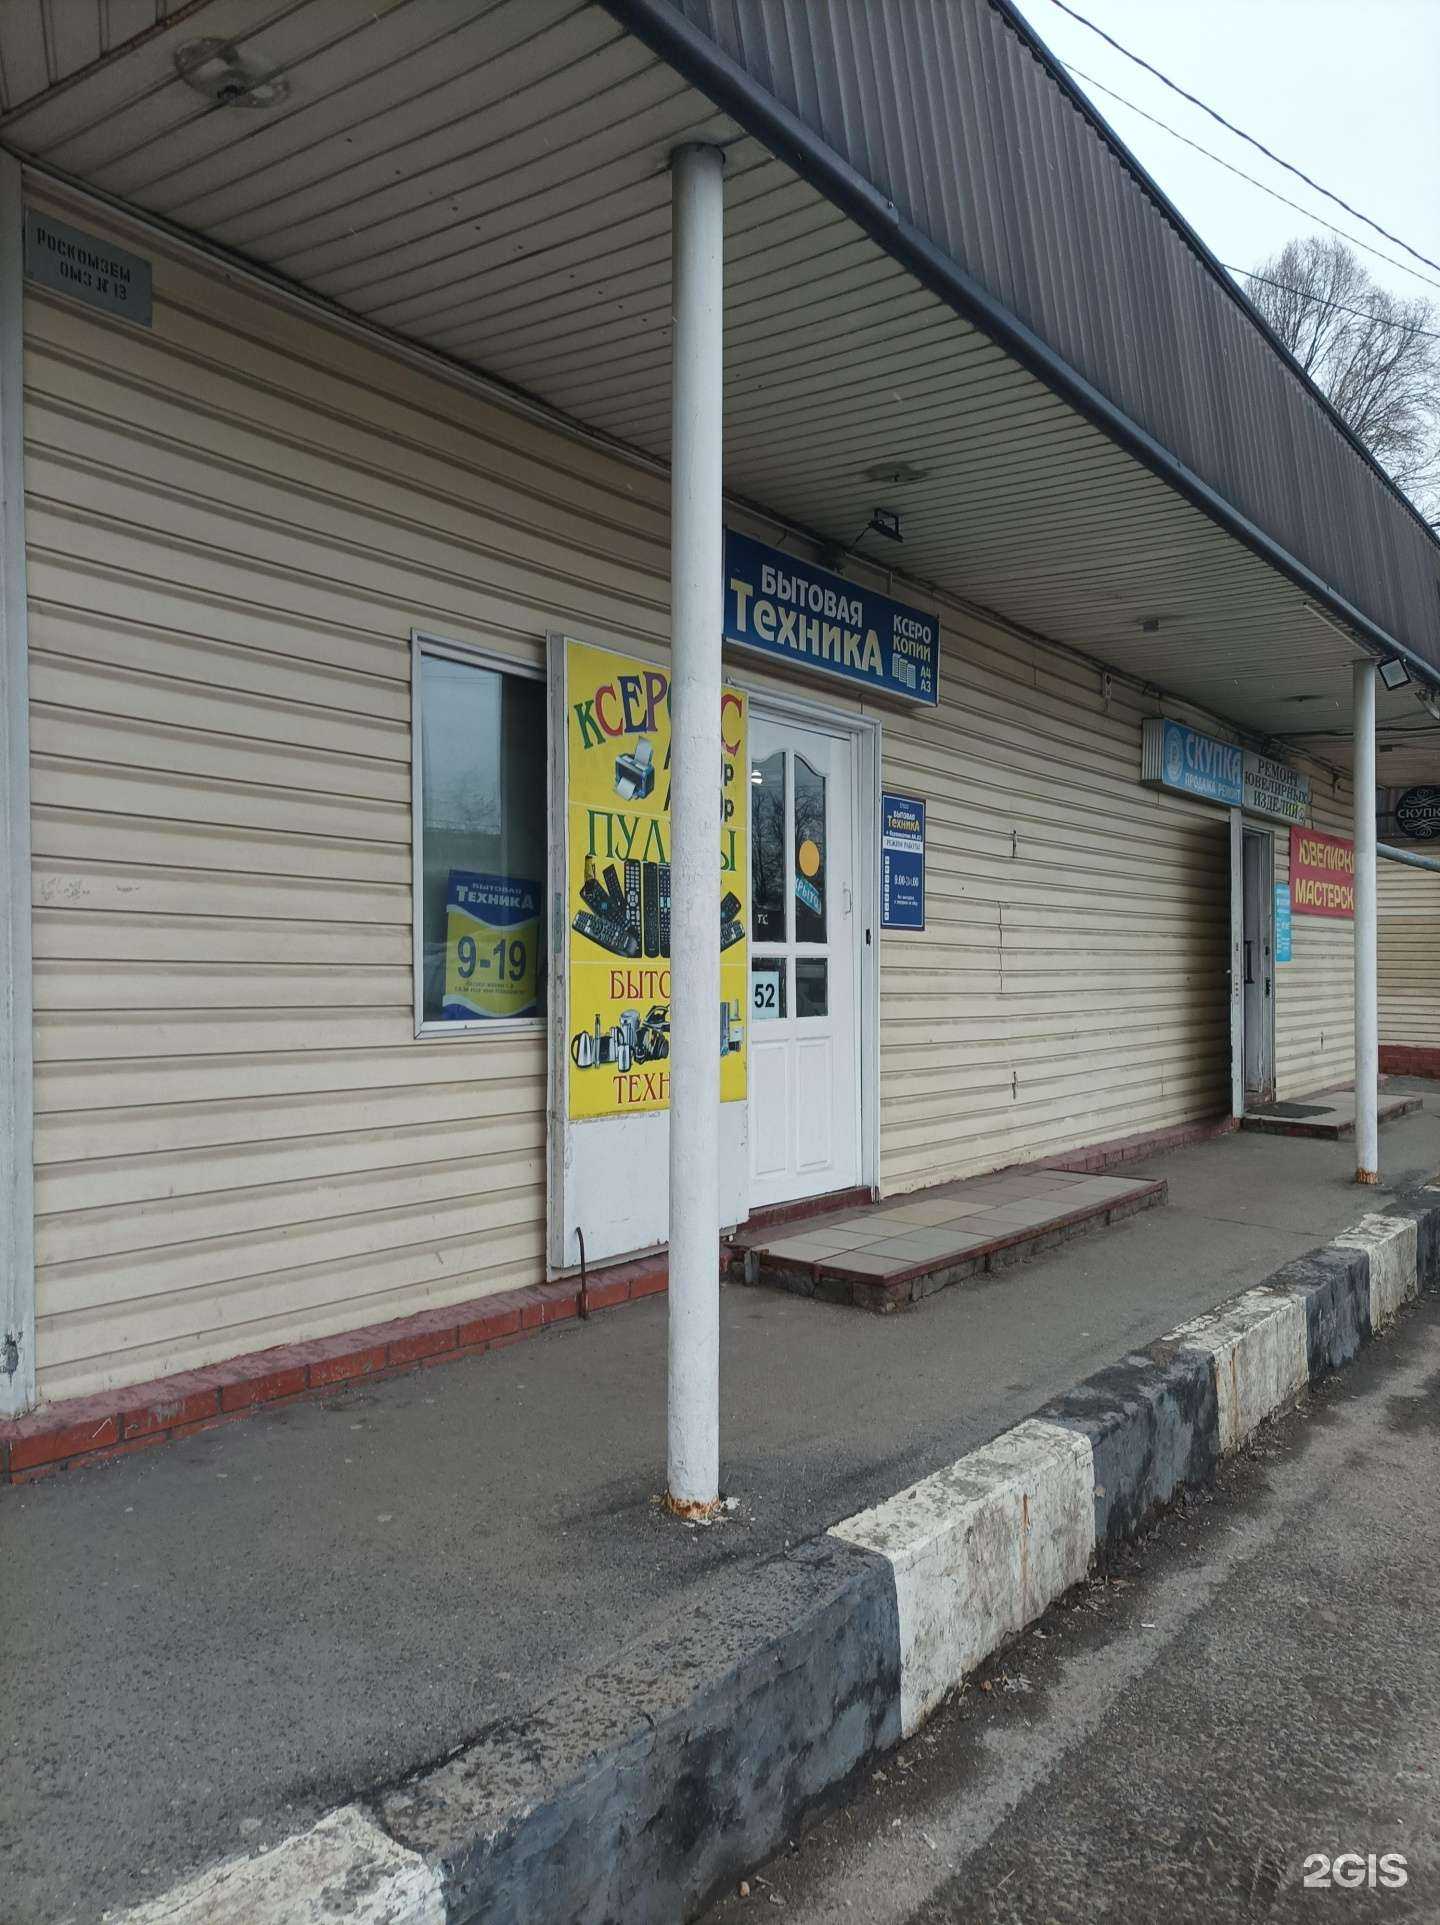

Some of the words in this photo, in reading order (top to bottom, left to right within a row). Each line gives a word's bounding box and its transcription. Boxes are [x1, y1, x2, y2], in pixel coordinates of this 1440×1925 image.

[60, 261, 92, 287] ОМЗ
[113, 282, 127, 300] 13
[761, 564, 863, 628] БЫТОВАЯ
[893, 614, 932, 643] КСЕРО
[893, 634, 931, 662] КОПИИ
[573, 671, 743, 757] КСЕРС
[1186, 733, 1241, 784] СКУПКА
[1258, 758, 1298, 787] РЕМОНТ
[1245, 771, 1308, 804] ЮВЕЛИРНЫХ
[1398, 807, 1440, 819] СКУПК
[587, 810, 736, 872] ПУЛЫ
[1295, 878, 1354, 911] МАСТЕРСК
[457, 936, 527, 982] 9-19
[610, 970, 671, 999] БЫТО
[754, 983, 775, 1008] 52
[613, 1072, 671, 1104] ТЕХН
